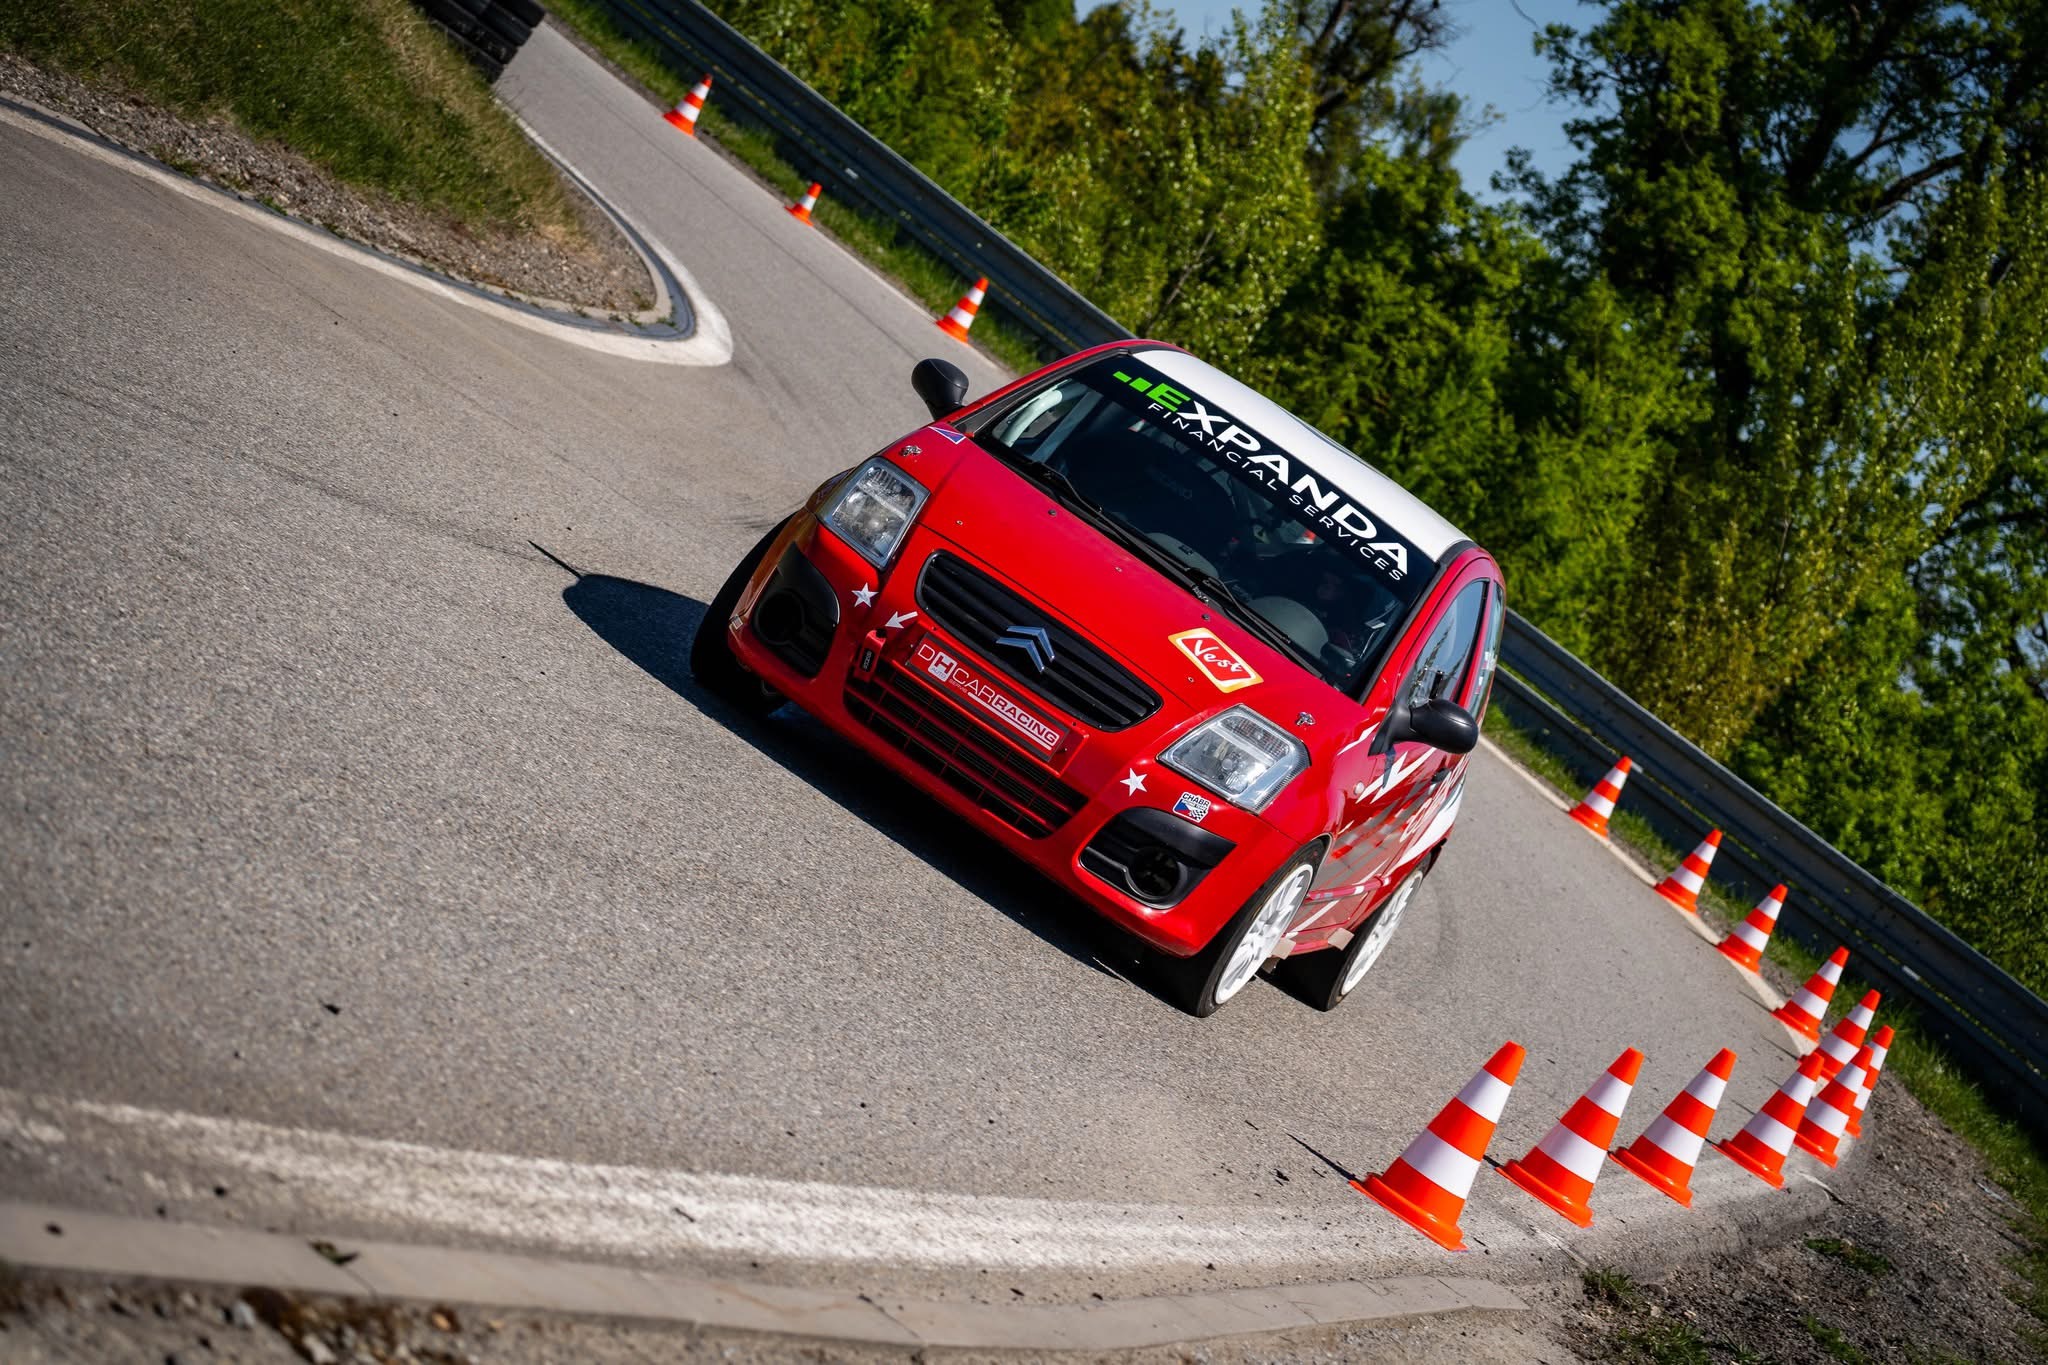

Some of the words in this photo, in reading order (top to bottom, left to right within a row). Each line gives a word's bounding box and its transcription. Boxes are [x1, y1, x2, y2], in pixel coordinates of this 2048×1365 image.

[1146, 382, 1408, 576] EXPANDA
[1148, 402, 1280, 491] FINANCIAL
[1289, 494, 1403, 581] SERVICES
[931, 667, 946, 679] AUTO
